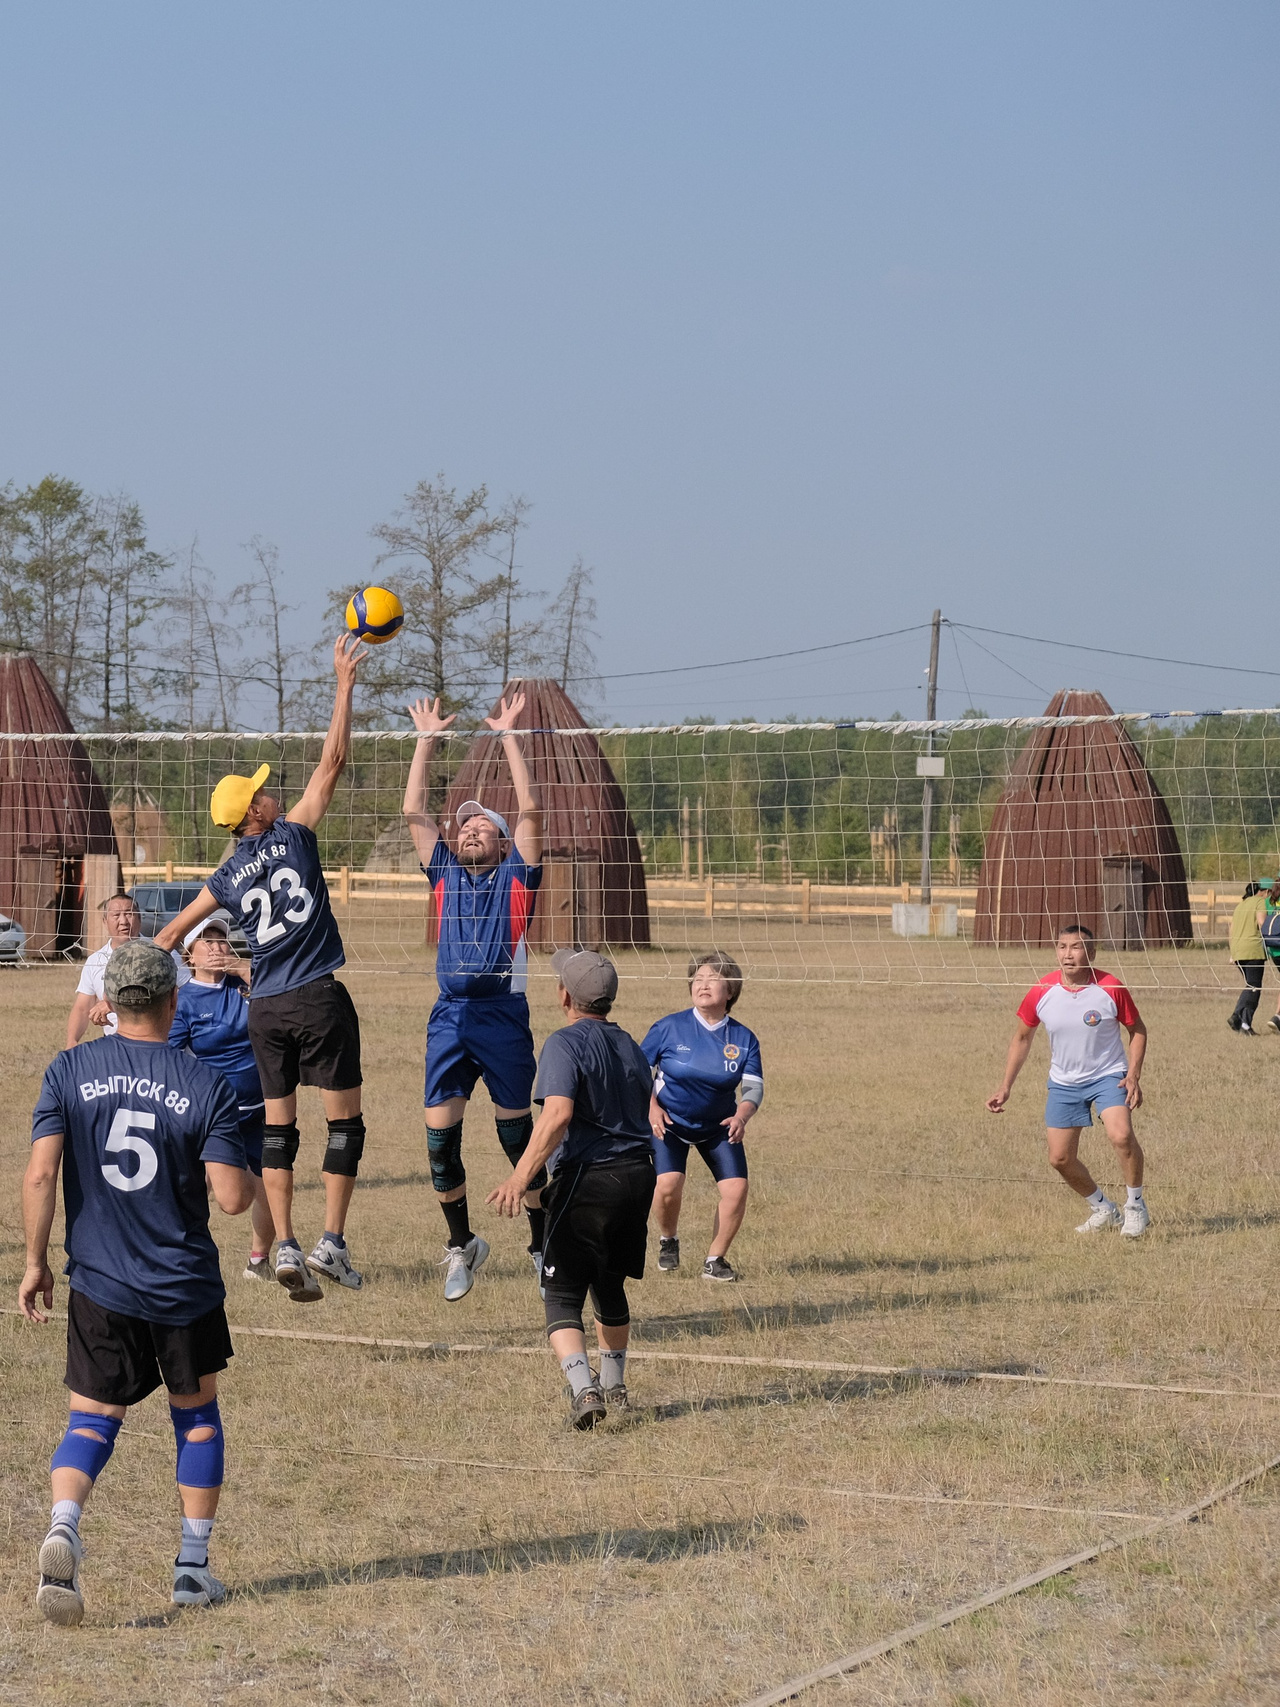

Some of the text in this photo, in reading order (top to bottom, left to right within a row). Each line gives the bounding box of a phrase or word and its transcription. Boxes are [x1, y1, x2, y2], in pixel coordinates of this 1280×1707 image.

[271, 845, 287, 857] 88
[241, 867, 314, 945] 23
[723, 1060, 739, 1073] 10
[79, 1075, 191, 1115] ВЫПУСК 88
[101, 1108, 159, 1192] 5
[565, 1359, 585, 1372] ILA
